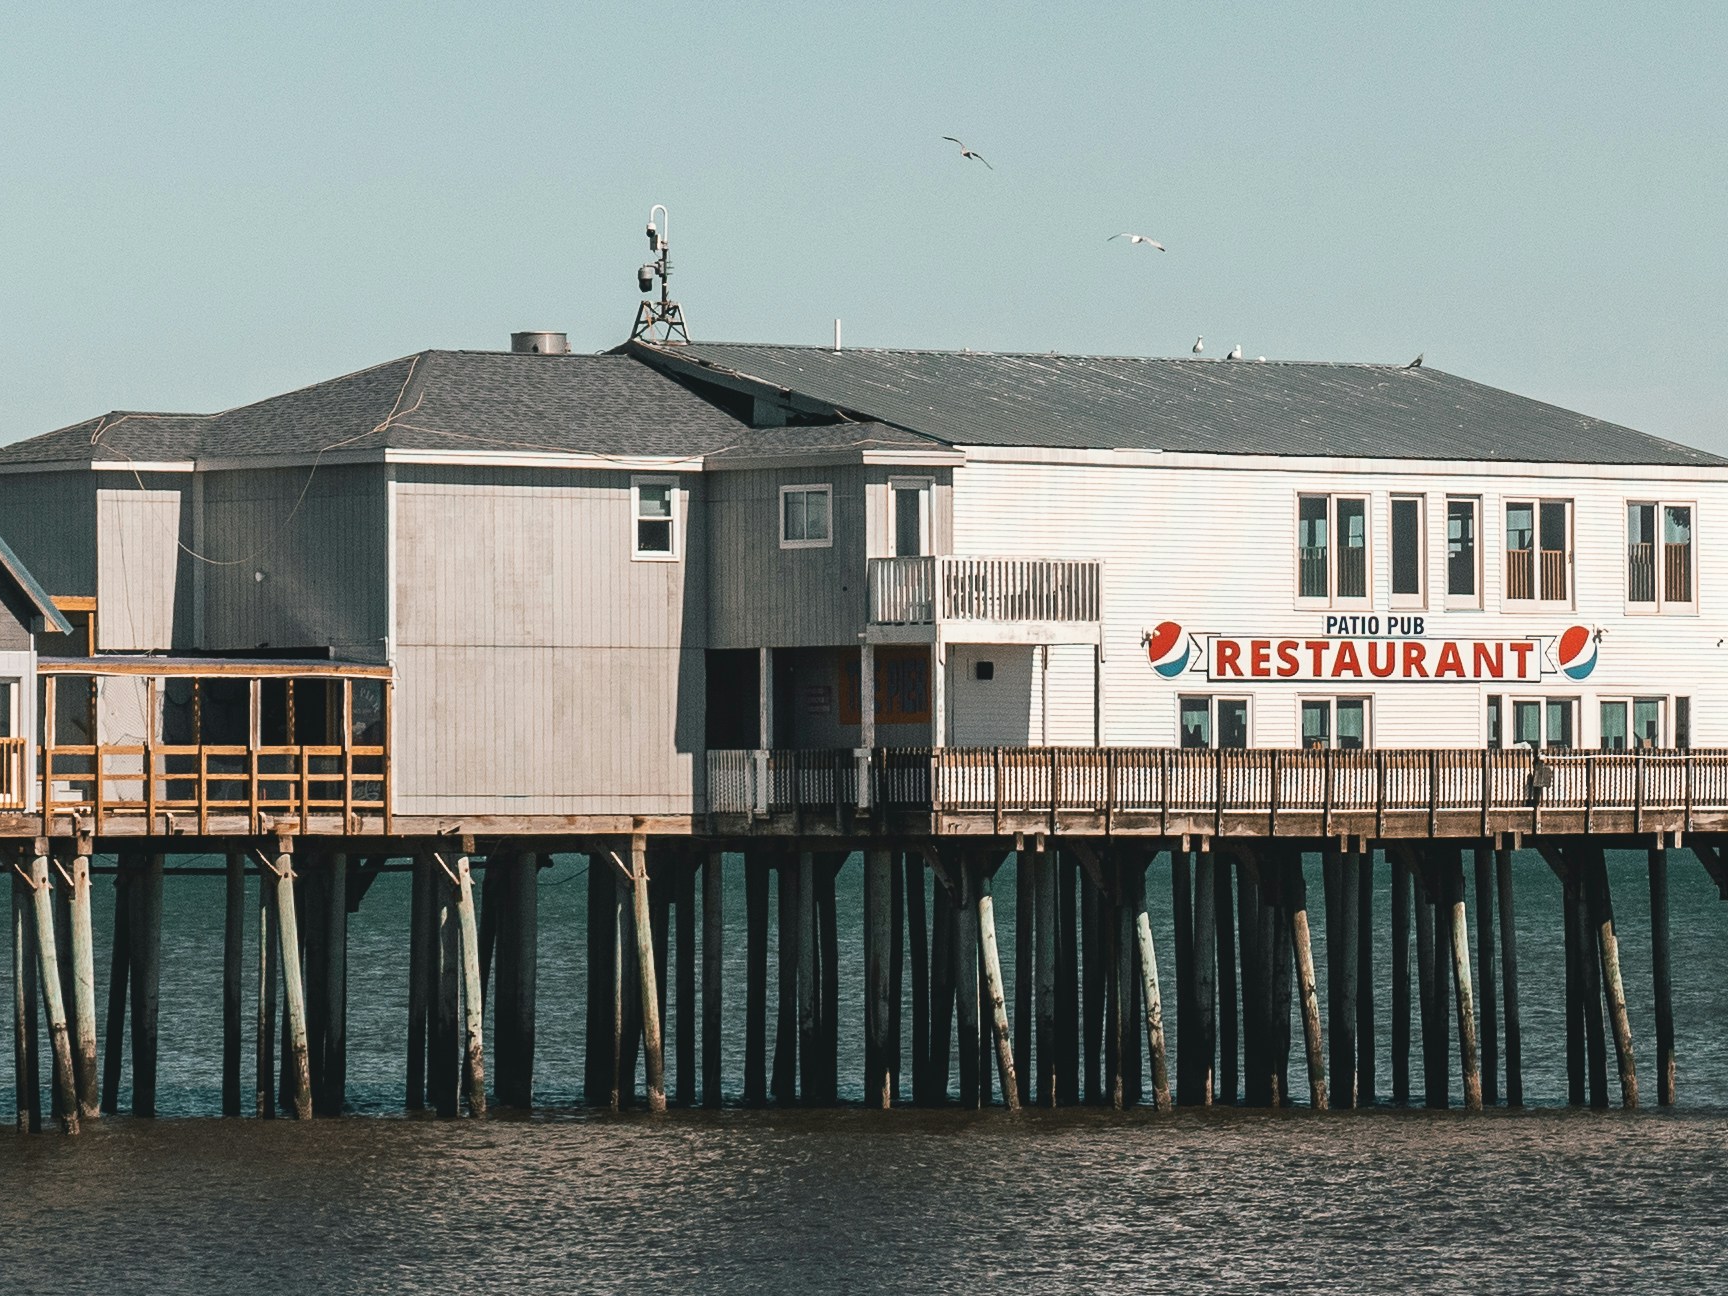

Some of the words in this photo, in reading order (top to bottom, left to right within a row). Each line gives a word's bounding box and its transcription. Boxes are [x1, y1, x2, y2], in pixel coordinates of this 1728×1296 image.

[1326, 615, 1380, 635] PATIO
[1387, 616, 1425, 635] PUB
[1216, 639, 1534, 679] RESTAURANT
